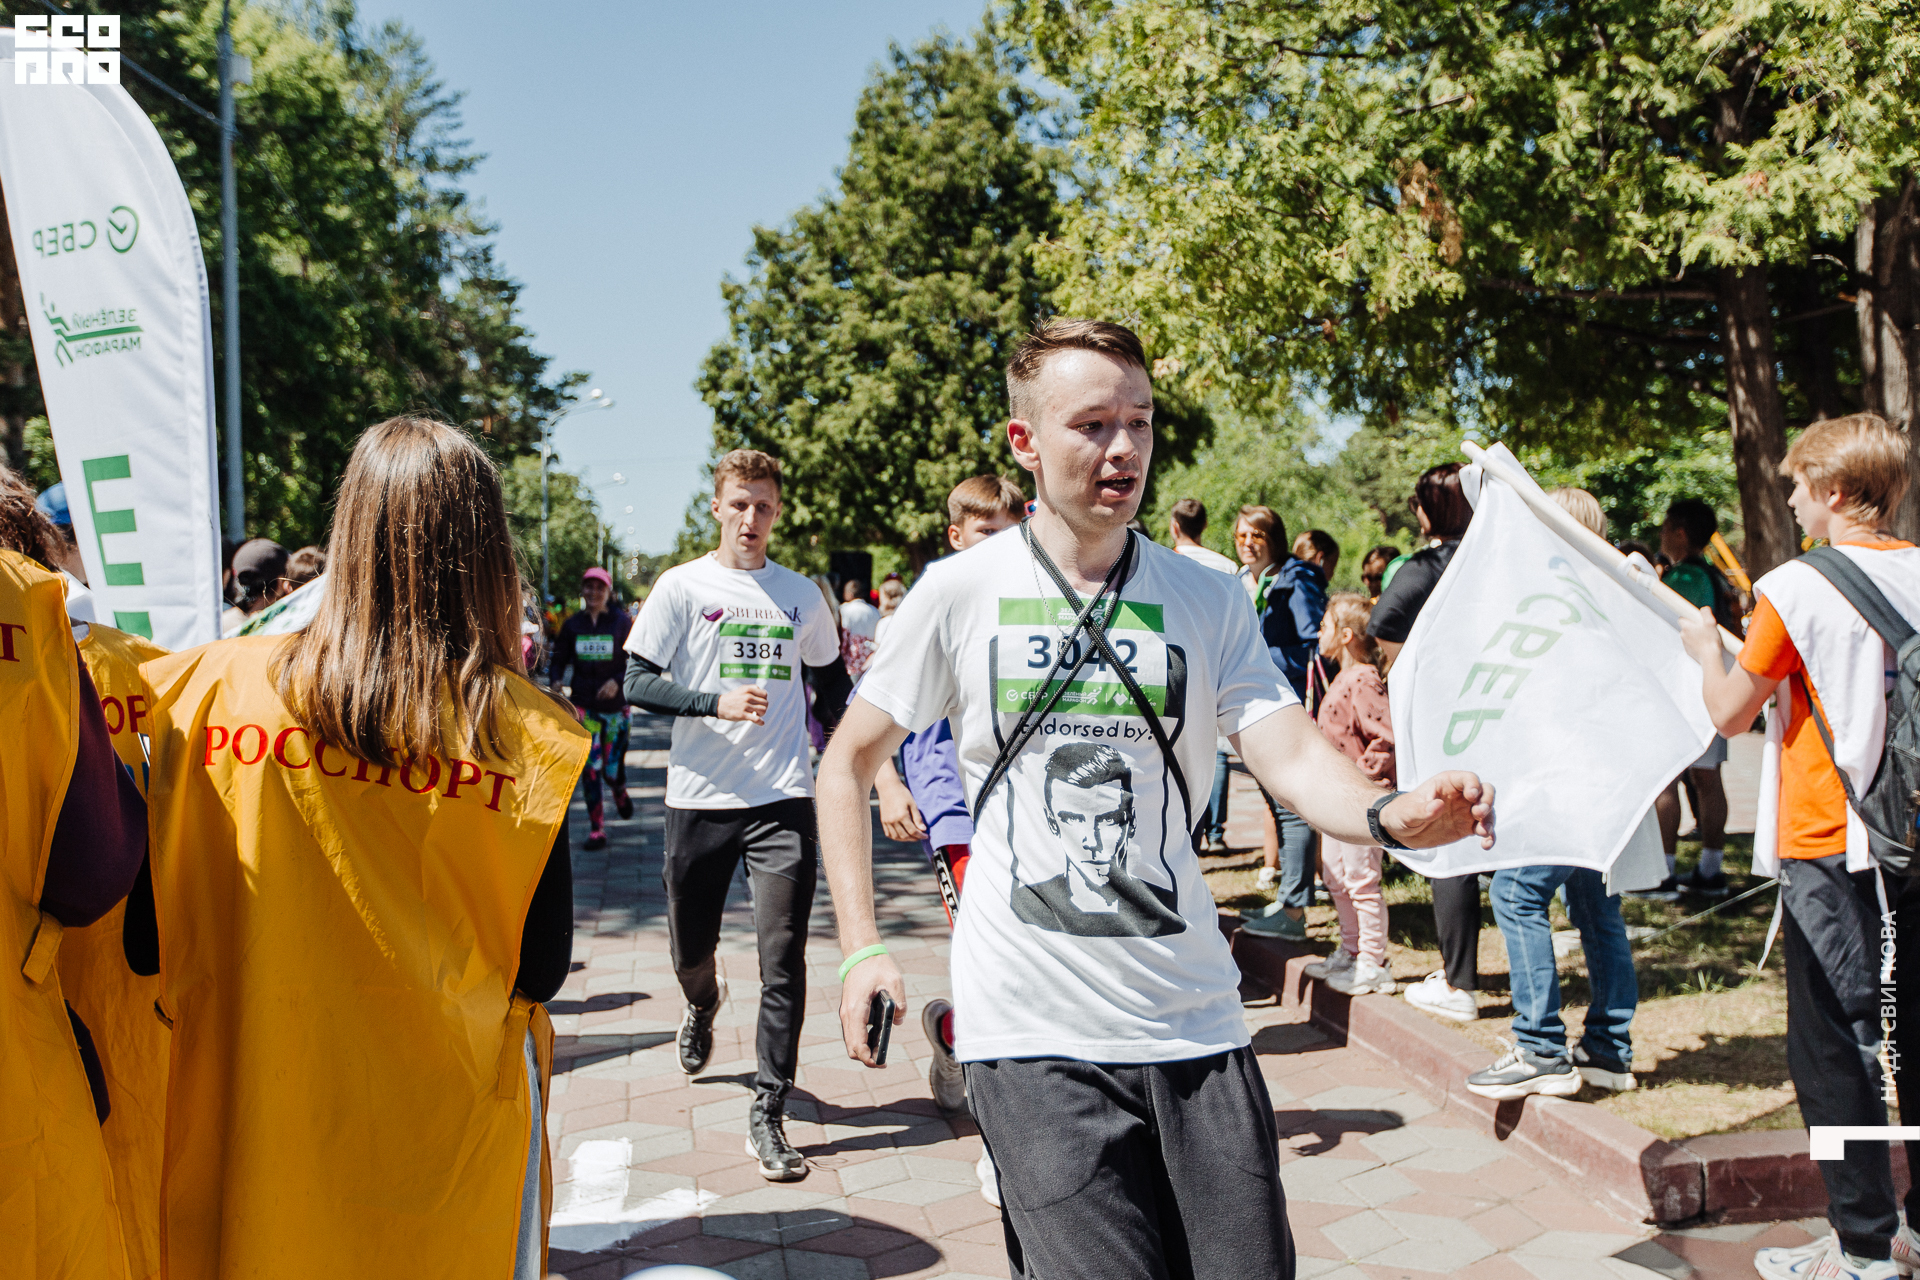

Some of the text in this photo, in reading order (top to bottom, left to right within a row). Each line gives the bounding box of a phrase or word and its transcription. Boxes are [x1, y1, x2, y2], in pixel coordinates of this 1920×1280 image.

[733, 642, 783, 660] 3384
[1027, 634, 1137, 674] 3042
[1020, 691, 1048, 700] СБР
